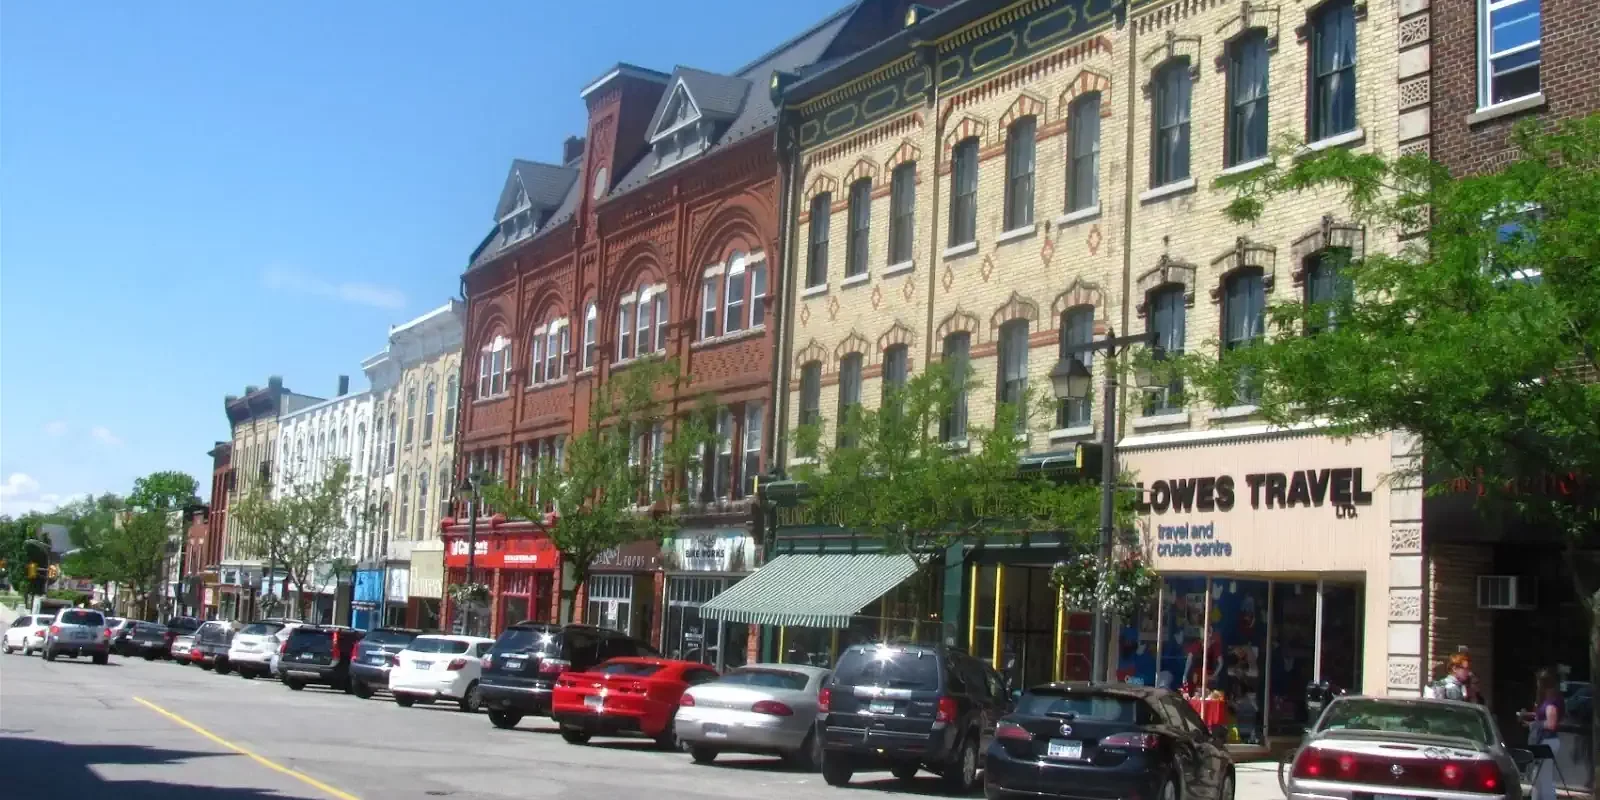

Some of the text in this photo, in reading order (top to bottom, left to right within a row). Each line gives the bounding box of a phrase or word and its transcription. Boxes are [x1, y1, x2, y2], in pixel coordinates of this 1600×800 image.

[1117, 467, 1373, 516] LOWES TRAVEL
[1335, 504, 1358, 519] LTD.
[1157, 521, 1214, 543] travel and
[701, 548, 725, 558] WORKS
[1157, 540, 1232, 557] cruise centre
